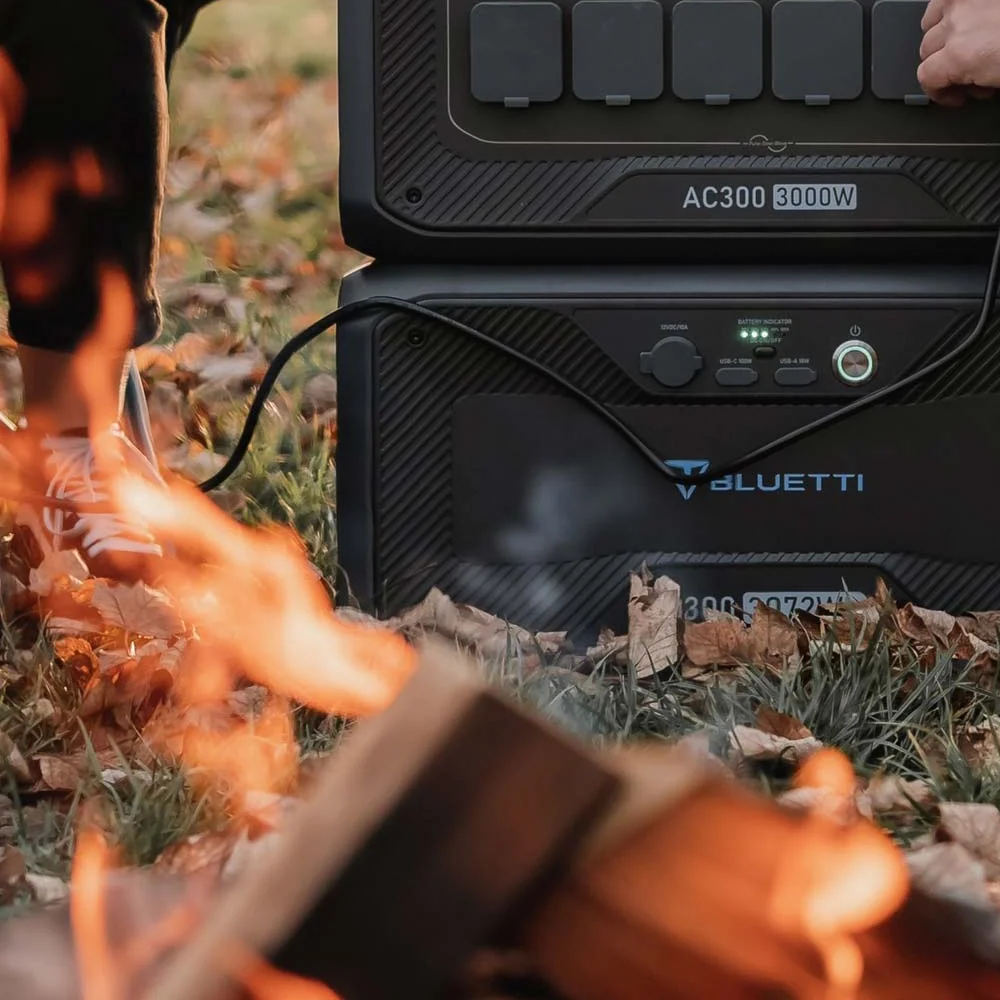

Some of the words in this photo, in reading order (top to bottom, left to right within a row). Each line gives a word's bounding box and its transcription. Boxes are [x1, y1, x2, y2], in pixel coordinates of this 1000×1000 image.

[683, 186, 766, 208] AC300
[776, 187, 854, 206] 3000W
[710, 474, 864, 491] BLUETTI
